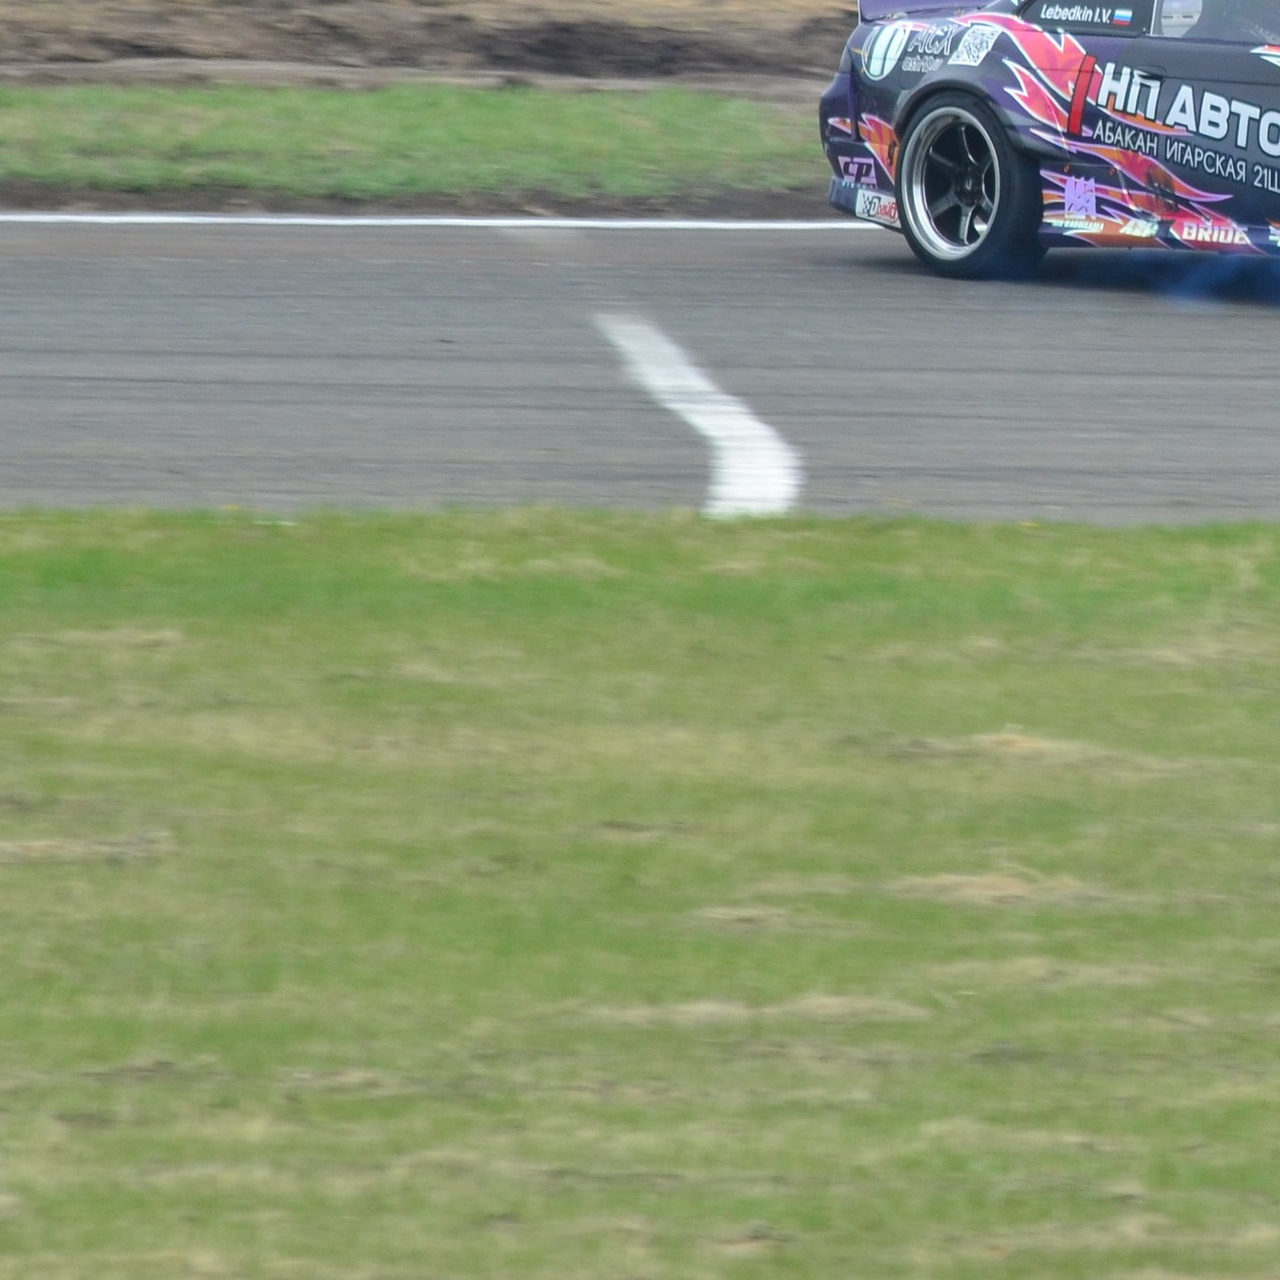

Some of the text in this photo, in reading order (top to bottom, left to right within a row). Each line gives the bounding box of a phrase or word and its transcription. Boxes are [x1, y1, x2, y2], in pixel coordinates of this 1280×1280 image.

[1040, 3, 1093, 22] Lebedkin
[1097, 62, 1161, 120] НП
[1093, 119, 1158, 156] АБАКАН
[1166, 139, 1247, 183] ИГАРСКАЯ
[1181, 221, 1249, 246] BRIDE
